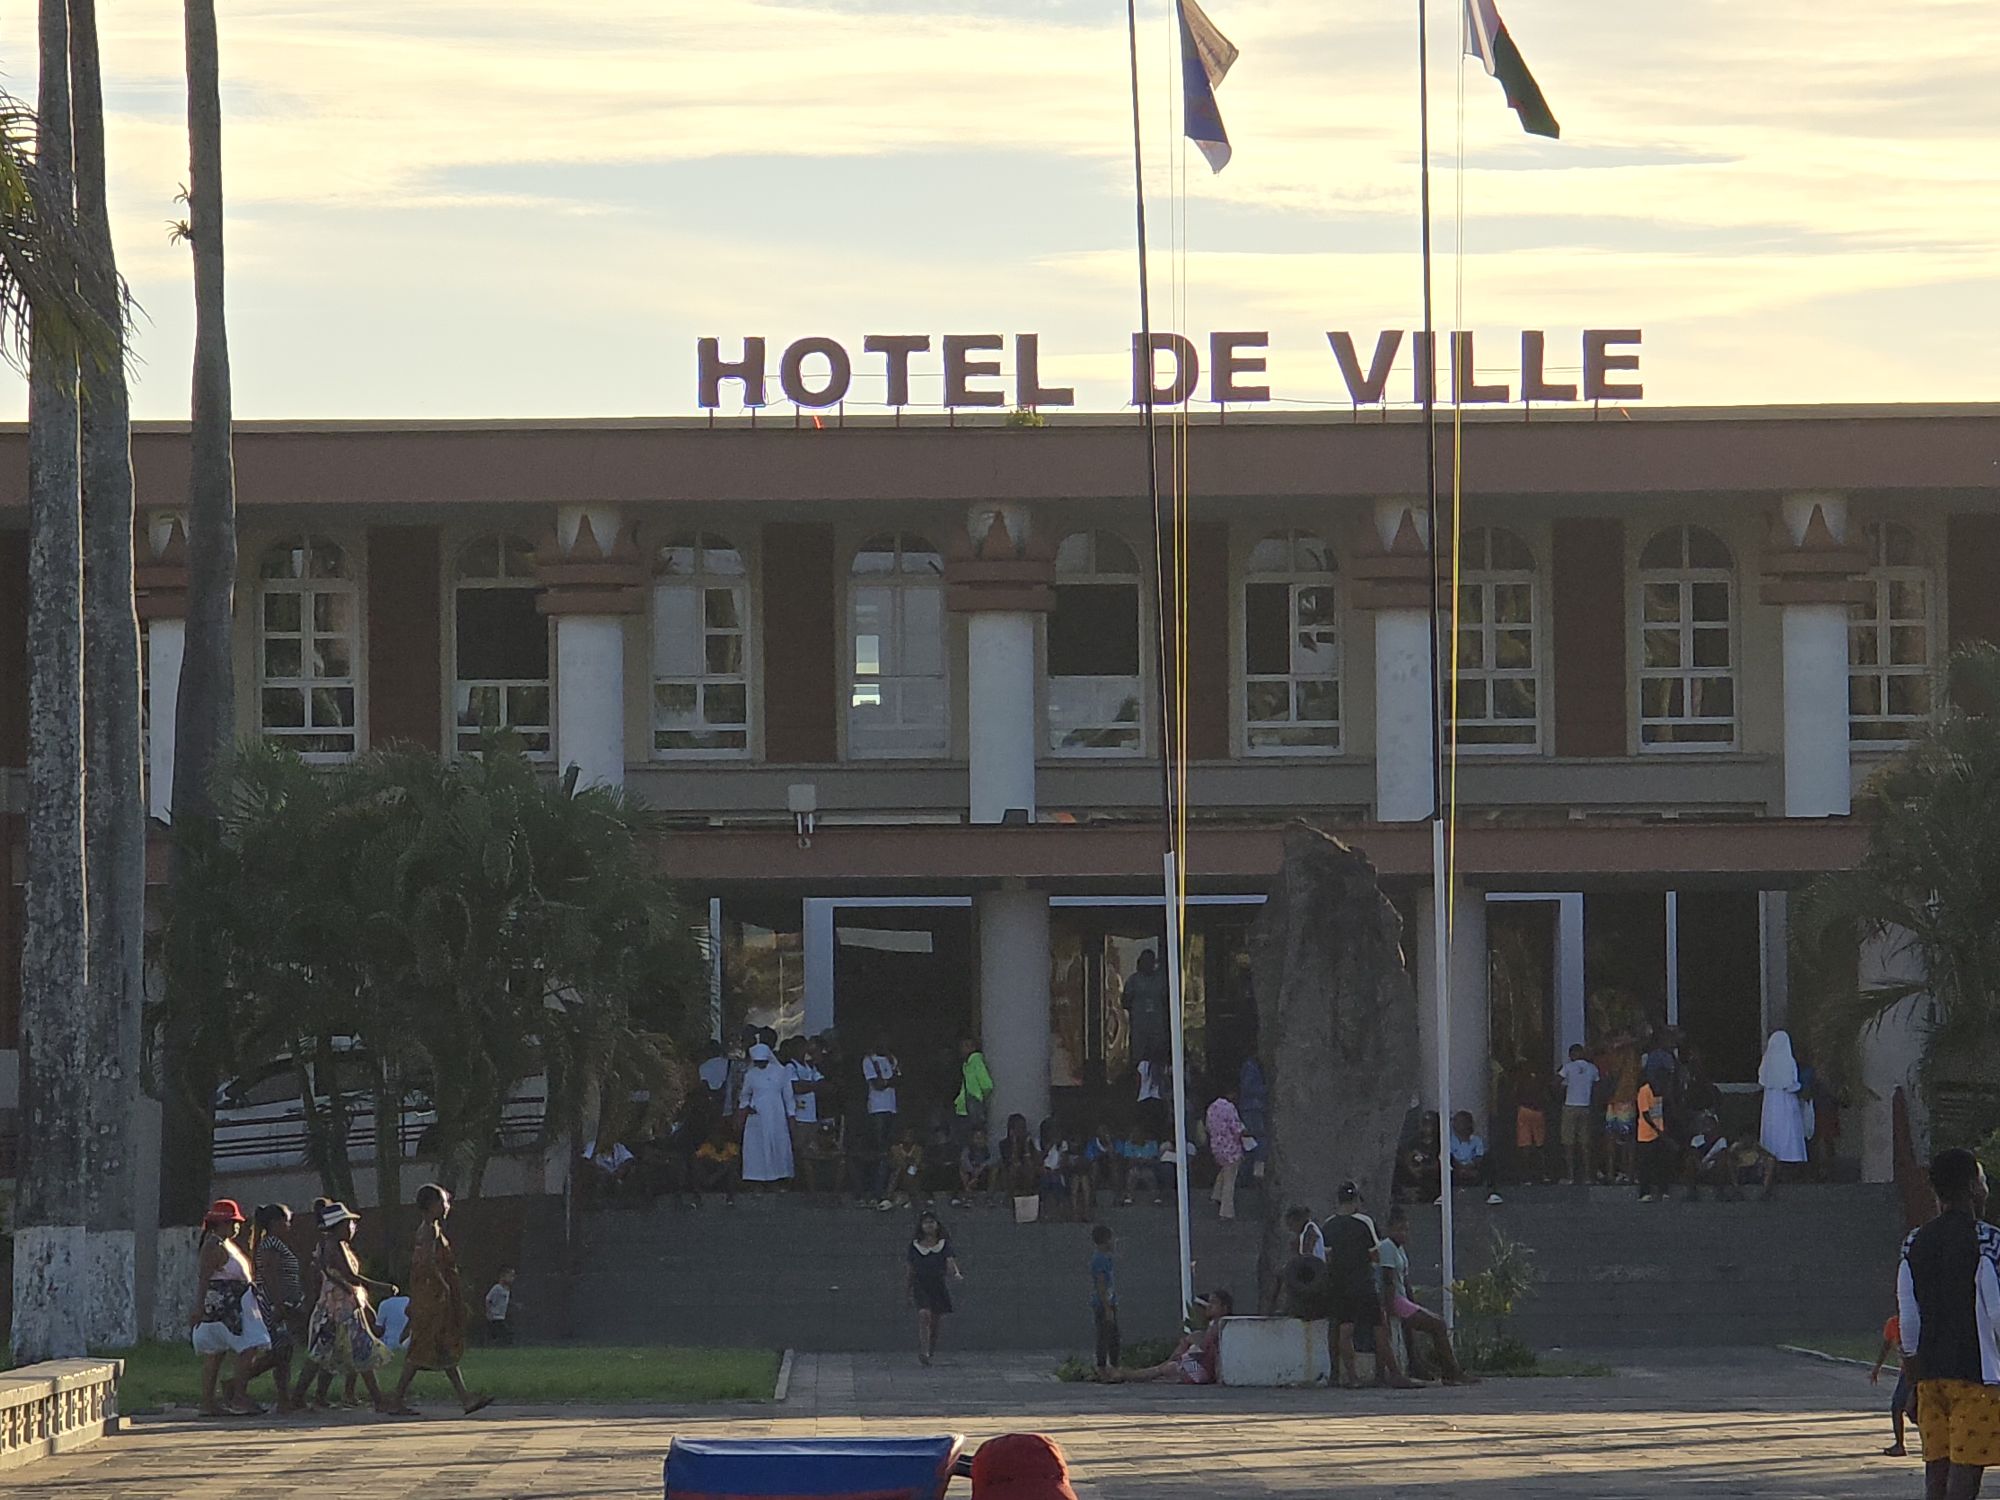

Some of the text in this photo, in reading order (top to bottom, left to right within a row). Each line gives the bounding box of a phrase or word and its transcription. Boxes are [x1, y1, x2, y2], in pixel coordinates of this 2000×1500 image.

[698, 329, 1643, 409] HOTEL DE VILLE
